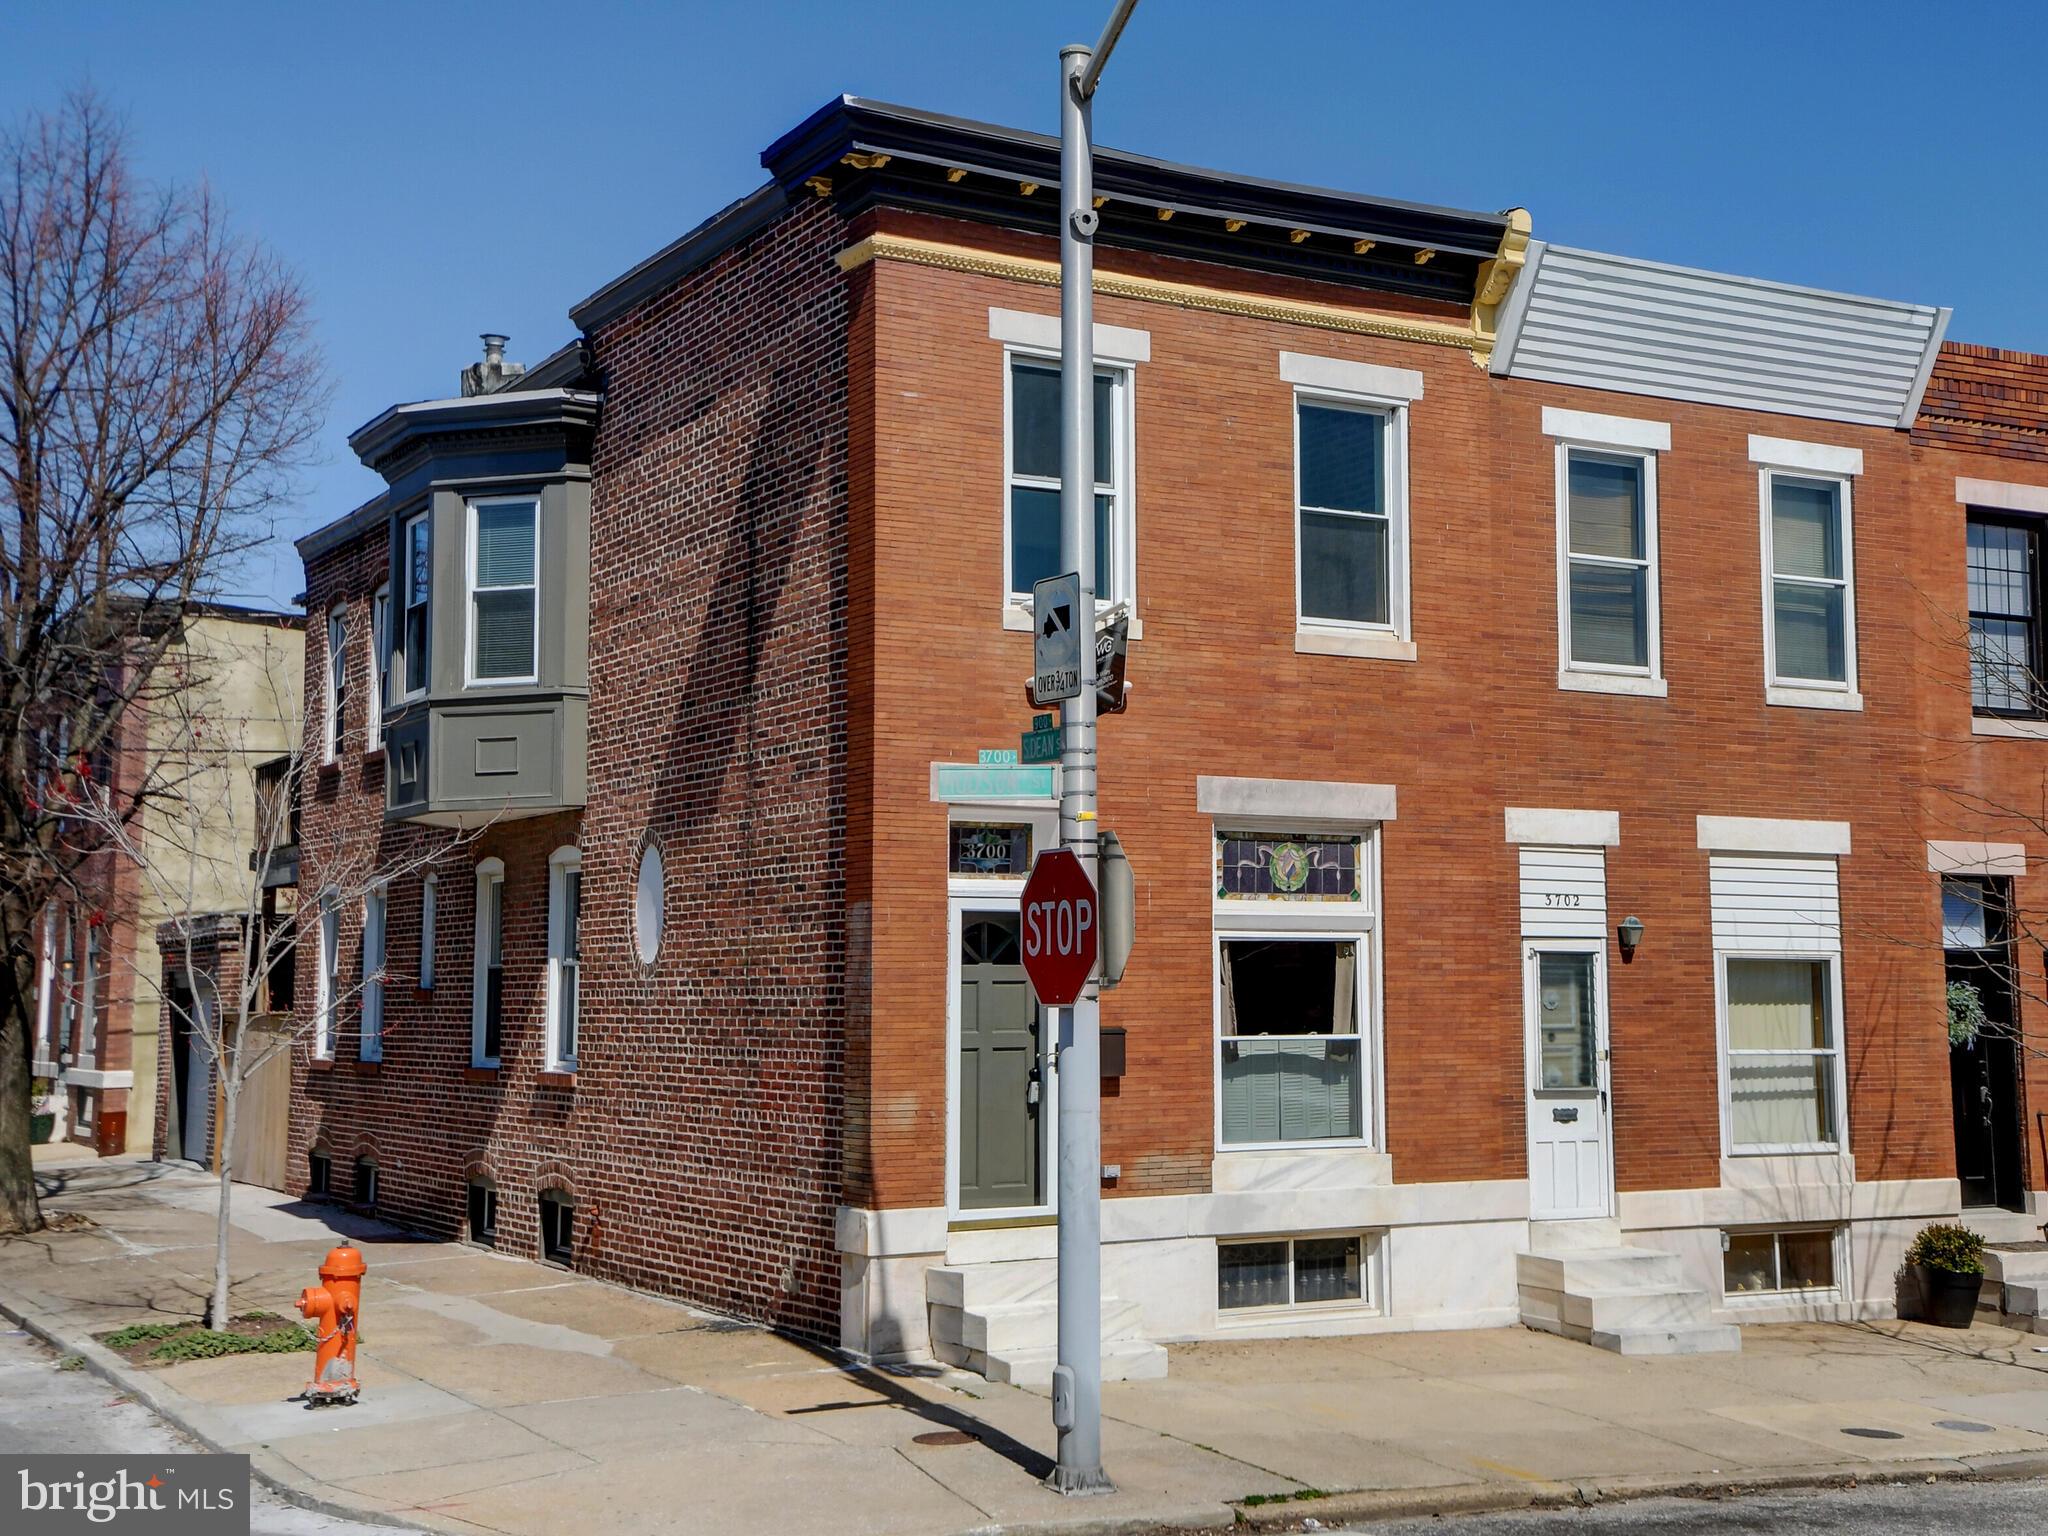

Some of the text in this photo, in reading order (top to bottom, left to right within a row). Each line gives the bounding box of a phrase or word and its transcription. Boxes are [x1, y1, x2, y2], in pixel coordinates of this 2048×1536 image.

[1038, 674, 1055, 693] OVER
[1065, 669, 1078, 688] TON
[979, 750, 1010, 764] 3700
[963, 843, 1006, 859] 3700
[1545, 894, 1580, 906] 3702
[1026, 899, 1093, 957] STOP
